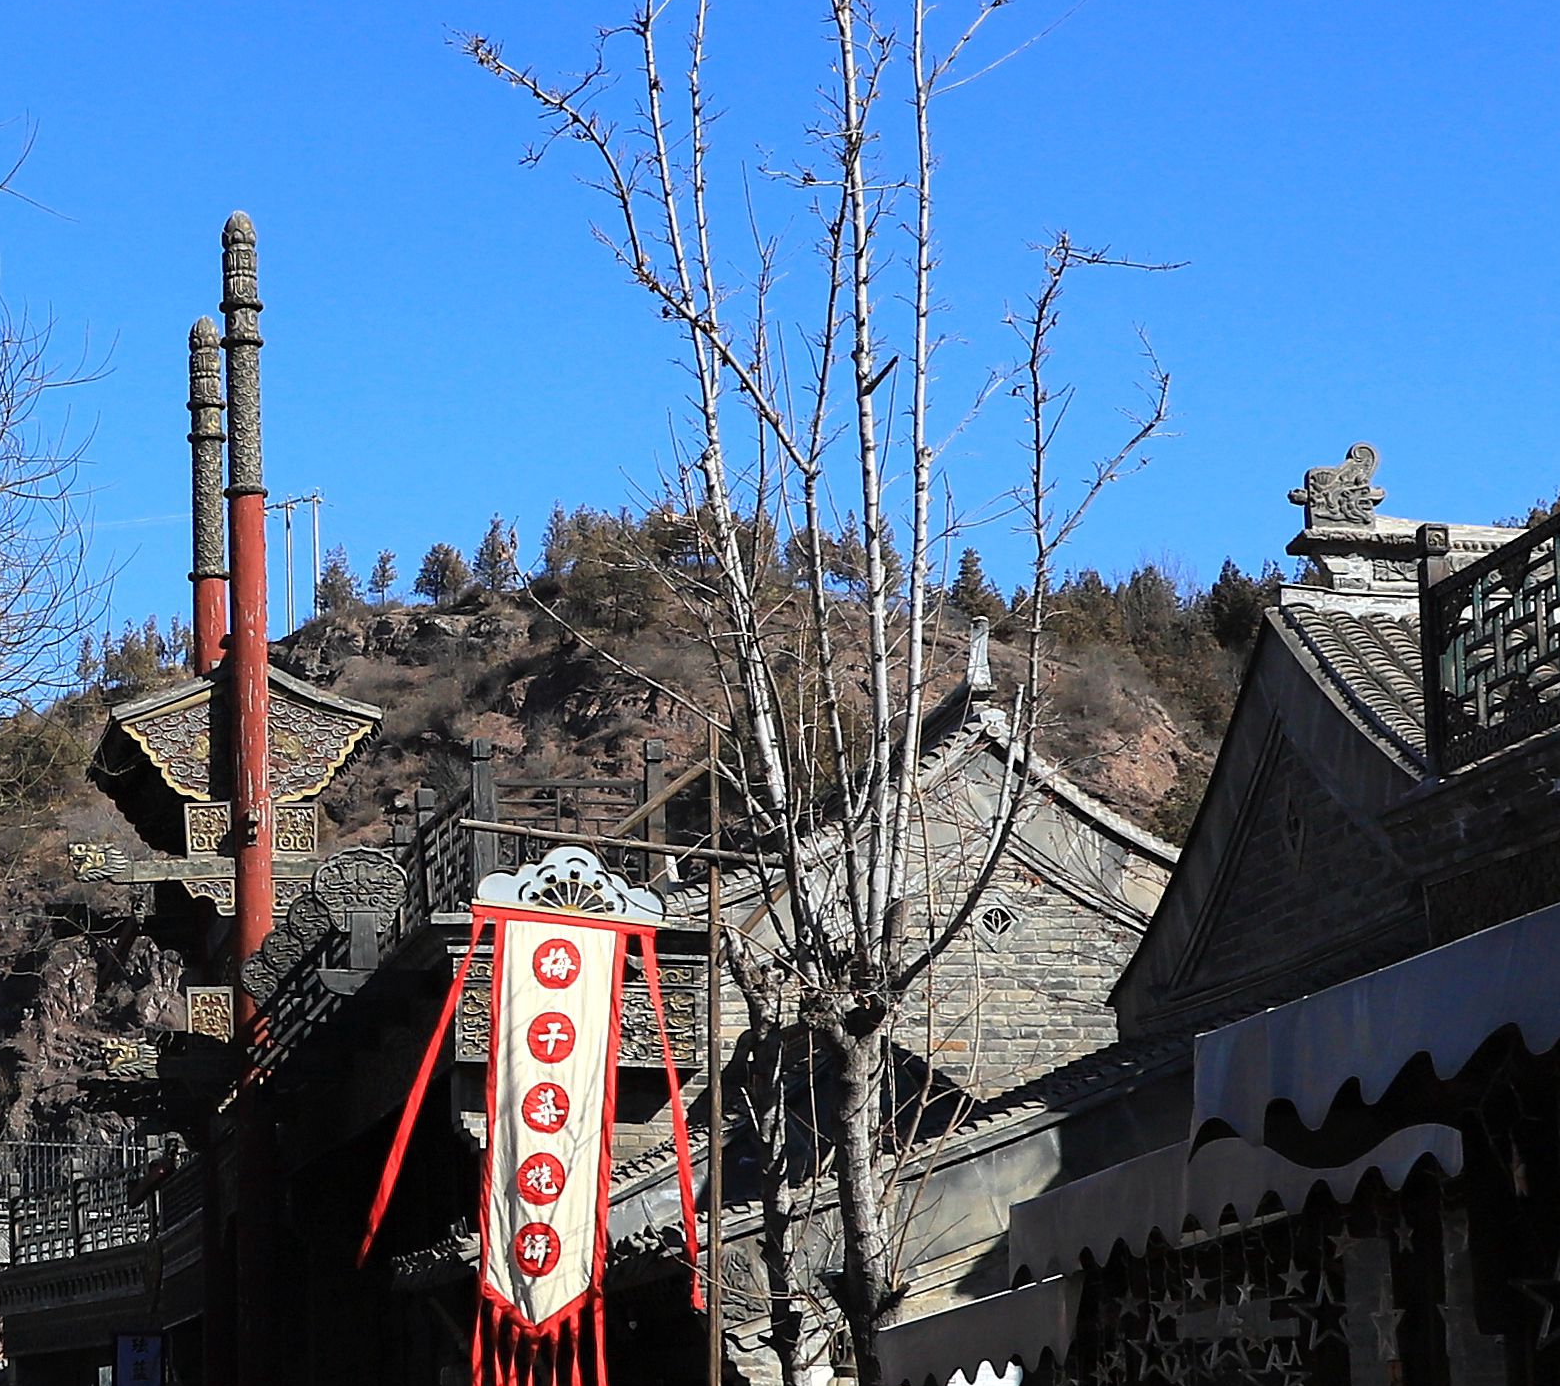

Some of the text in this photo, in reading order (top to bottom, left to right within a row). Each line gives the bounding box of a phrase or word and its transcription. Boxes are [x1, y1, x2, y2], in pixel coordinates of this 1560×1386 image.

[523, 946, 578, 1269] 梅干菜烧饼
